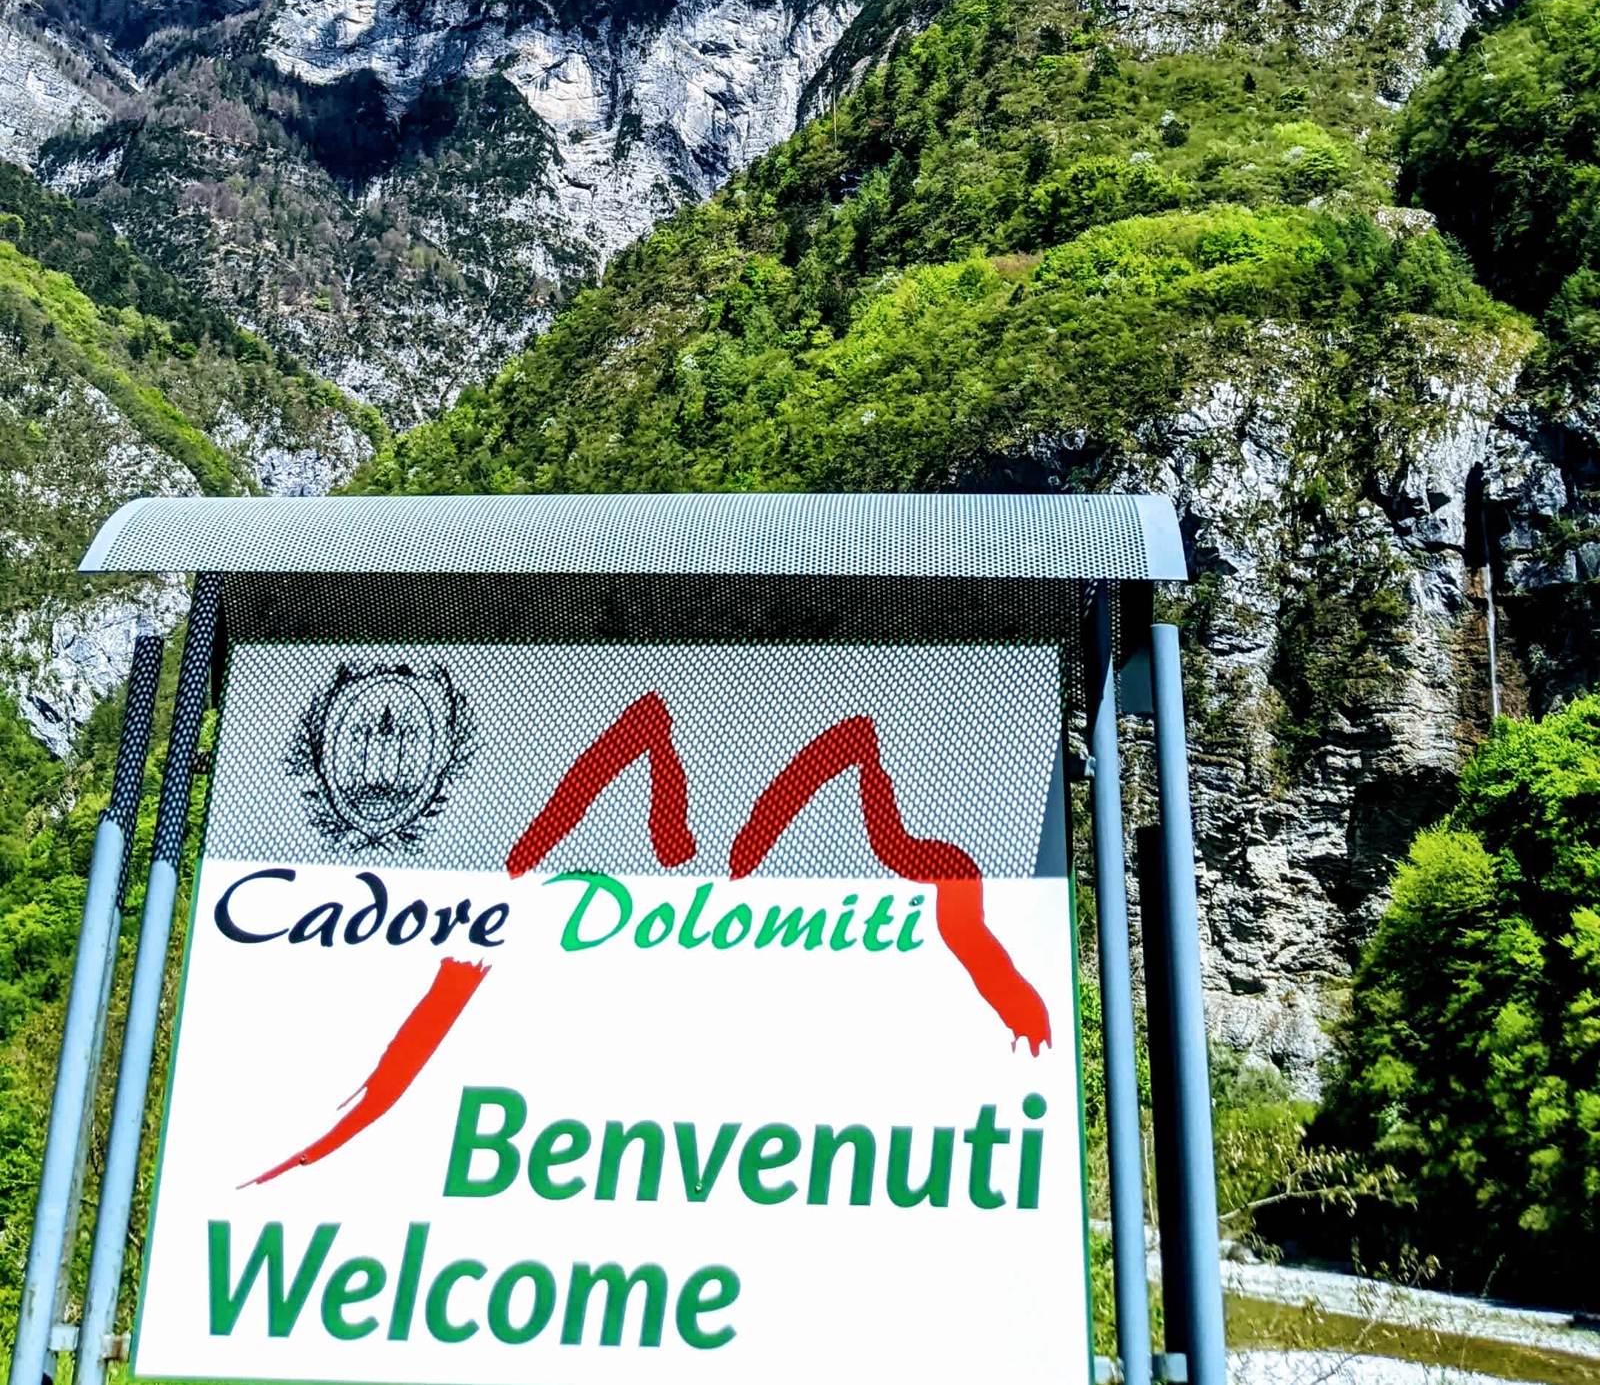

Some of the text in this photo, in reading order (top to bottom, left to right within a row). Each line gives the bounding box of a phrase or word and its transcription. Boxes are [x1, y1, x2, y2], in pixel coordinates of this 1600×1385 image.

[213, 868, 926, 954] Cadore Dolomiti
[443, 1085, 1048, 1211] Benvenuti
[206, 1220, 742, 1350] Welcome
